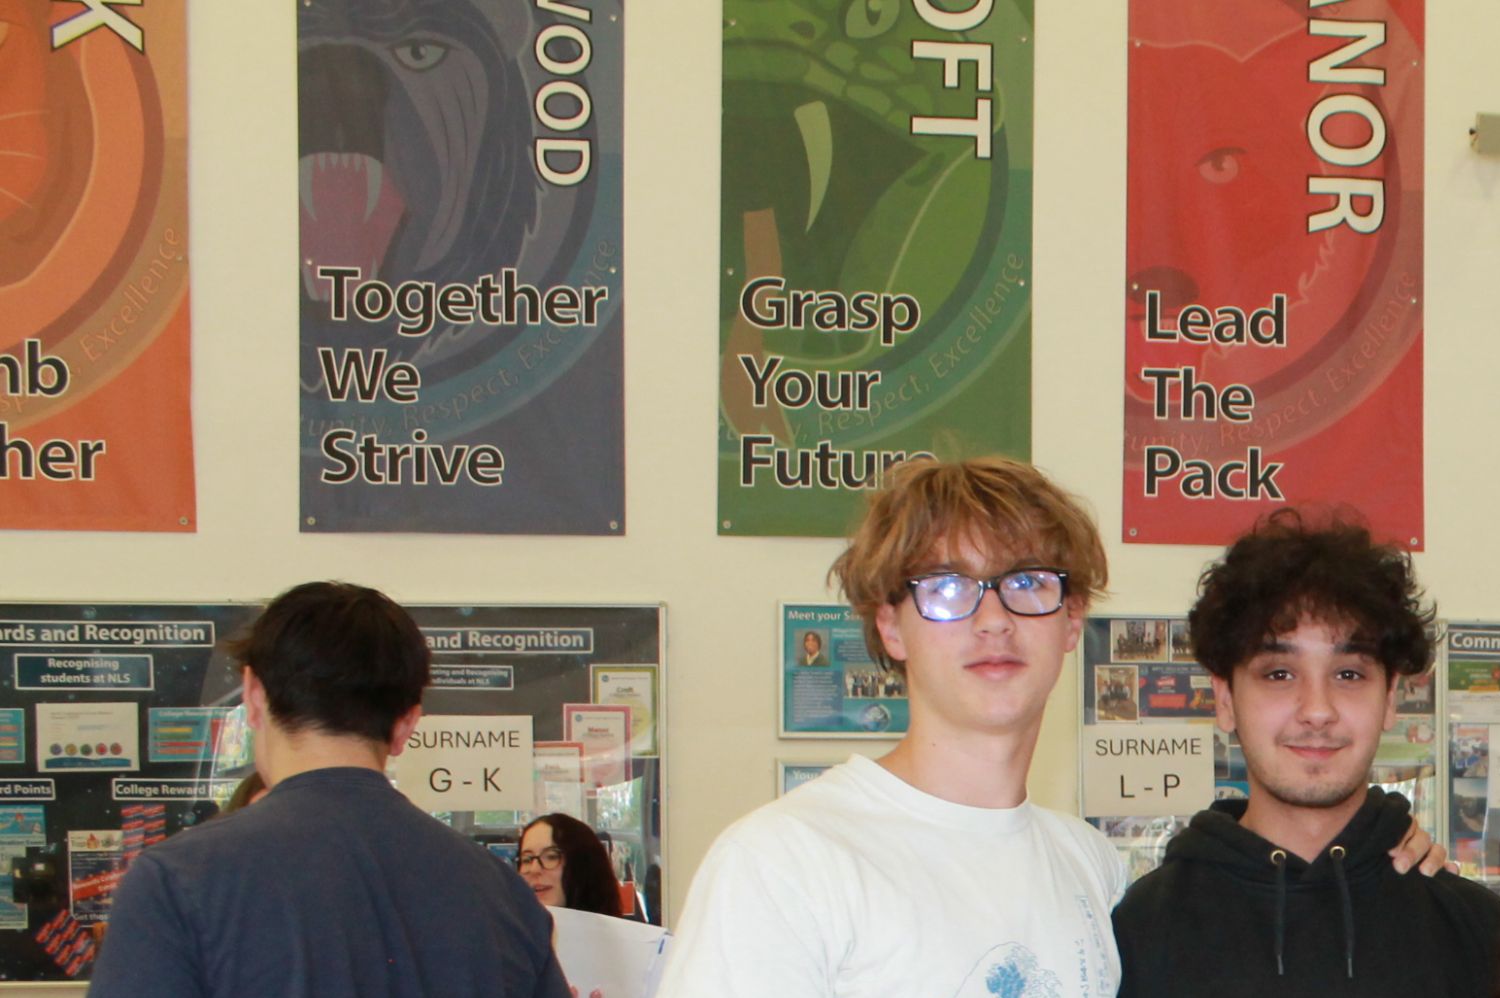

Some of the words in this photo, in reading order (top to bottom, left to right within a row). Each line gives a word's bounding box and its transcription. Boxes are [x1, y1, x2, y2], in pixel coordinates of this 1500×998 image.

[1305, 0, 1388, 234] NOR
[79, 227, 181, 364] Excellence
[317, 266, 608, 337] Together
[740, 276, 921, 347] Grasp
[928, 252, 1025, 380] Excellence
[1145, 289, 1287, 348] Lead
[317, 347, 421, 403] We
[737, 354, 882, 411] Your
[1220, 386, 1328, 448] Respect,
[1327, 271, 1418, 393] Excellence
[1142, 365, 1255, 422] The
[320, 428, 505, 485] Strive
[740, 434, 938, 489] Futur
[1144, 445, 1286, 501] Pack
[40, 625, 79, 642] and
[85, 623, 205, 645] Recognition
[427, 632, 462, 648] and
[468, 631, 585, 651] Recognition
[788, 610, 815, 620] Meet
[818, 612, 842, 624] your
[40, 672, 91, 684] students
[93, 673, 106, 683] at
[108, 672, 131, 684] NLS
[47, 657, 120, 672] Recognising
[408, 730, 521, 748] SURNAME
[1095, 738, 1203, 756] SURNAME
[14, 783, 51, 795] Points
[115, 783, 159, 798] College
[161, 782, 207, 796] Reward
[429, 767, 452, 792] G
[483, 767, 503, 792] K
[1120, 774, 1135, 798] L
[1163, 774, 1181, 798] P
